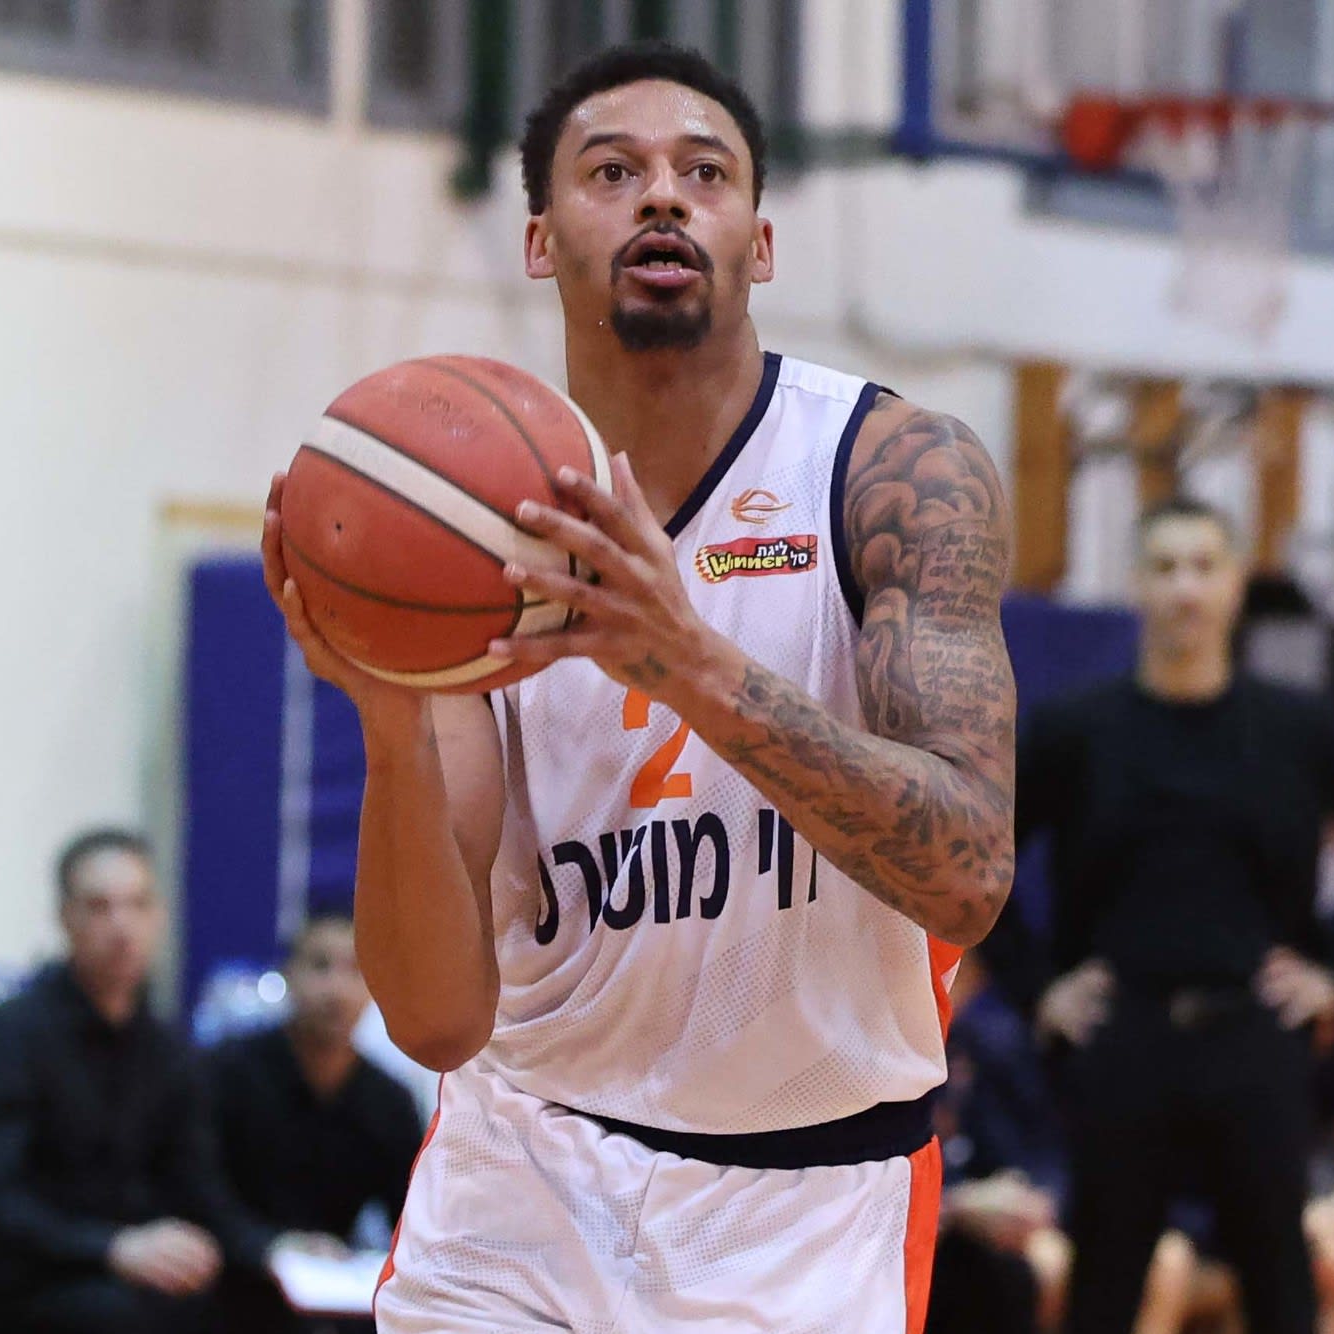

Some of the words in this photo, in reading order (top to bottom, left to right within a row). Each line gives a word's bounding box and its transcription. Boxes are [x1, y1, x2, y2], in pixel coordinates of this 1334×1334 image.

[757, 541, 788, 558] ליגת
[790, 551, 808, 567] סל
[710, 553, 789, 576] Winner
[623, 687, 693, 809] 2
